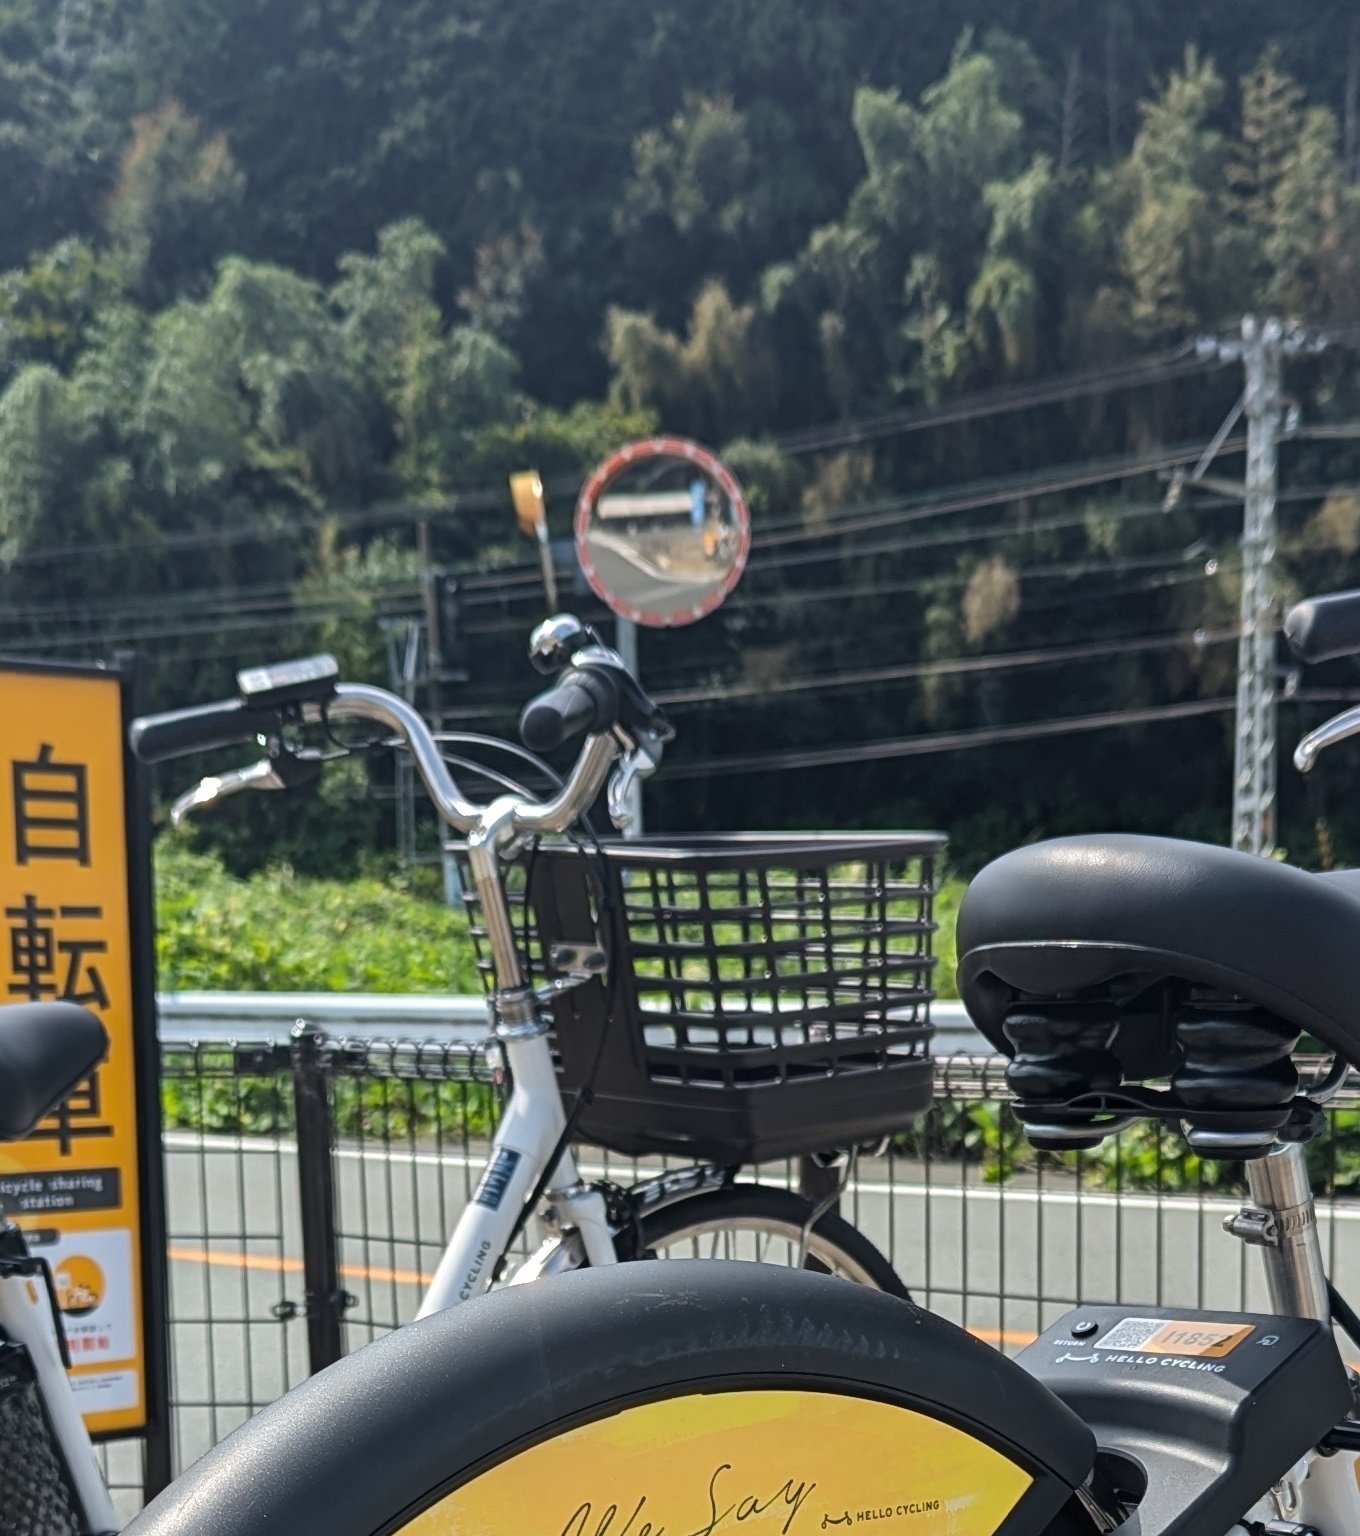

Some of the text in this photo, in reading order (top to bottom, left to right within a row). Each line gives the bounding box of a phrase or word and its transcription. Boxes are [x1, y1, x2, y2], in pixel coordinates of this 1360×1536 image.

[48, 1175, 103, 1192] sharing
[20, 1195, 74, 1209] station
[459, 1240, 491, 1300] CYCLING
[1104, 1354, 1227, 1373] HELLO CYCLING
[856, 1500, 941, 1523] HELLO CYCLING
